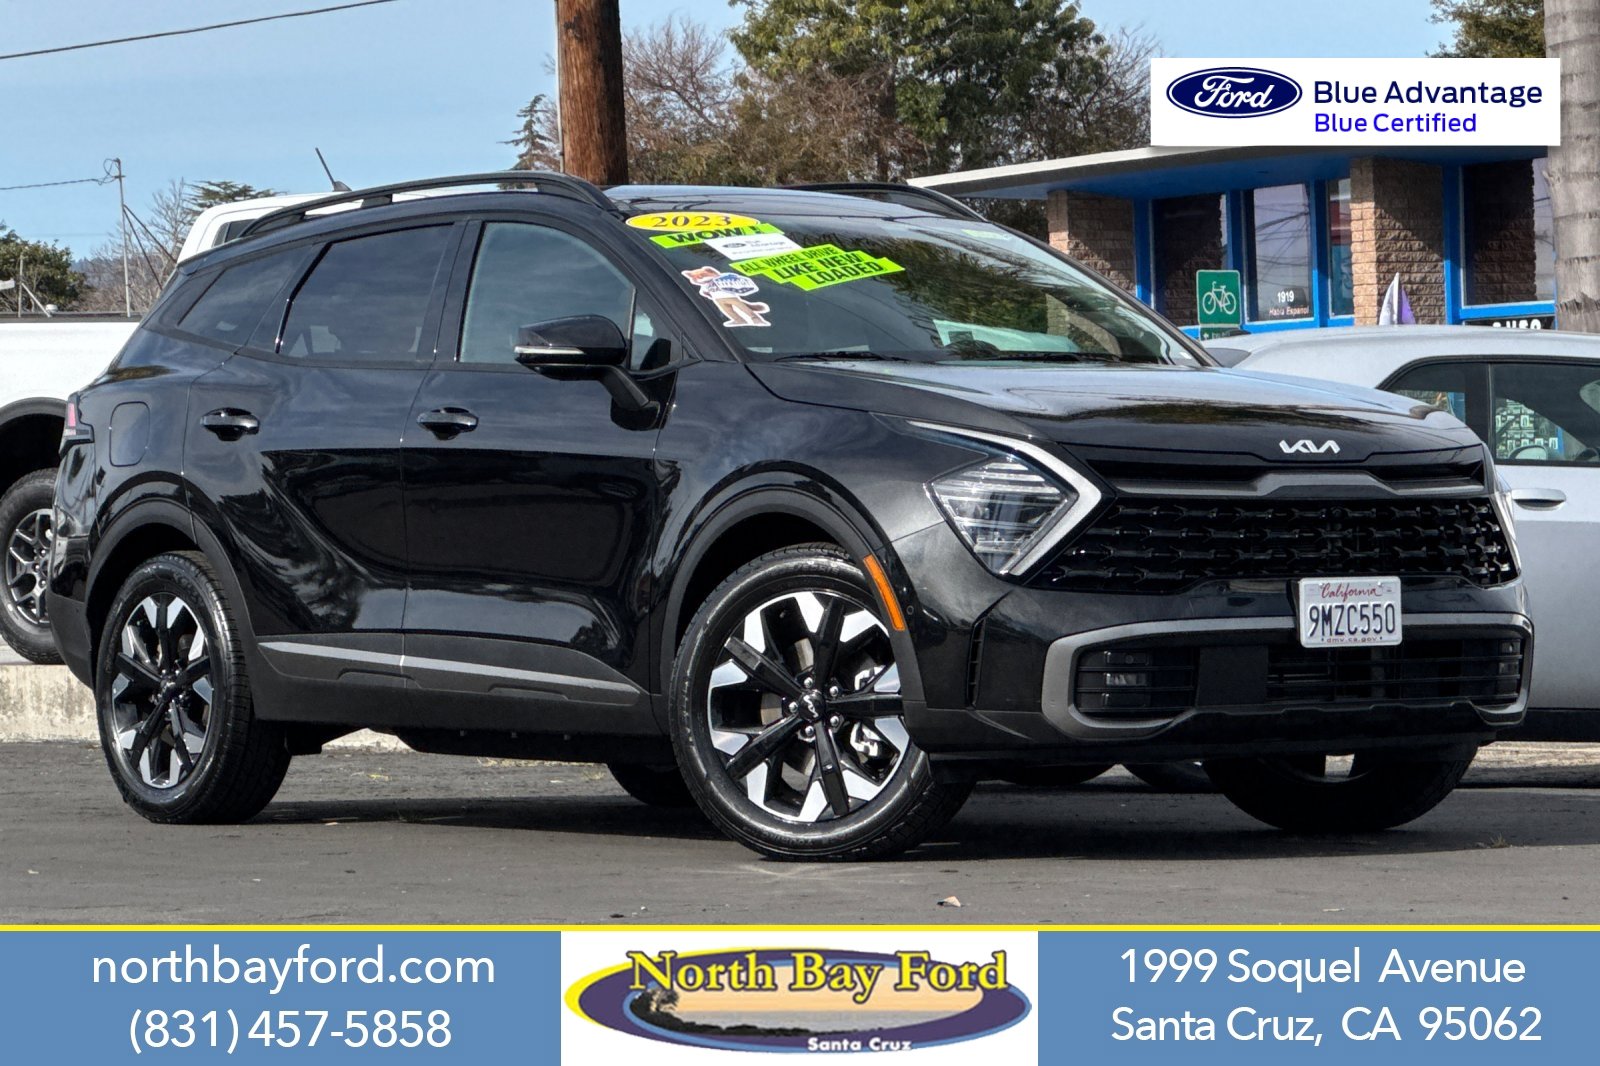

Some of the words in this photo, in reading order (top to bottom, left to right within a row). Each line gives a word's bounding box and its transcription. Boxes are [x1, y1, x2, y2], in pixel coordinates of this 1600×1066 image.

[650, 215, 732, 228] 2023
[738, 260, 768, 273] ALL
[760, 252, 805, 269] WHEEL
[802, 246, 840, 260] DRIVE
[771, 261, 818, 280] LIKE
[817, 251, 863, 270] NEW
[805, 260, 884, 286] LOADED
[1277, 290, 1295, 303] 1919
[1278, 439, 1341, 454] KIA
[1320, 582, 1383, 603] California
[1308, 602, 1396, 638] 9MZC550
[1326, 636, 1378, 644] dmv.ca.gov
